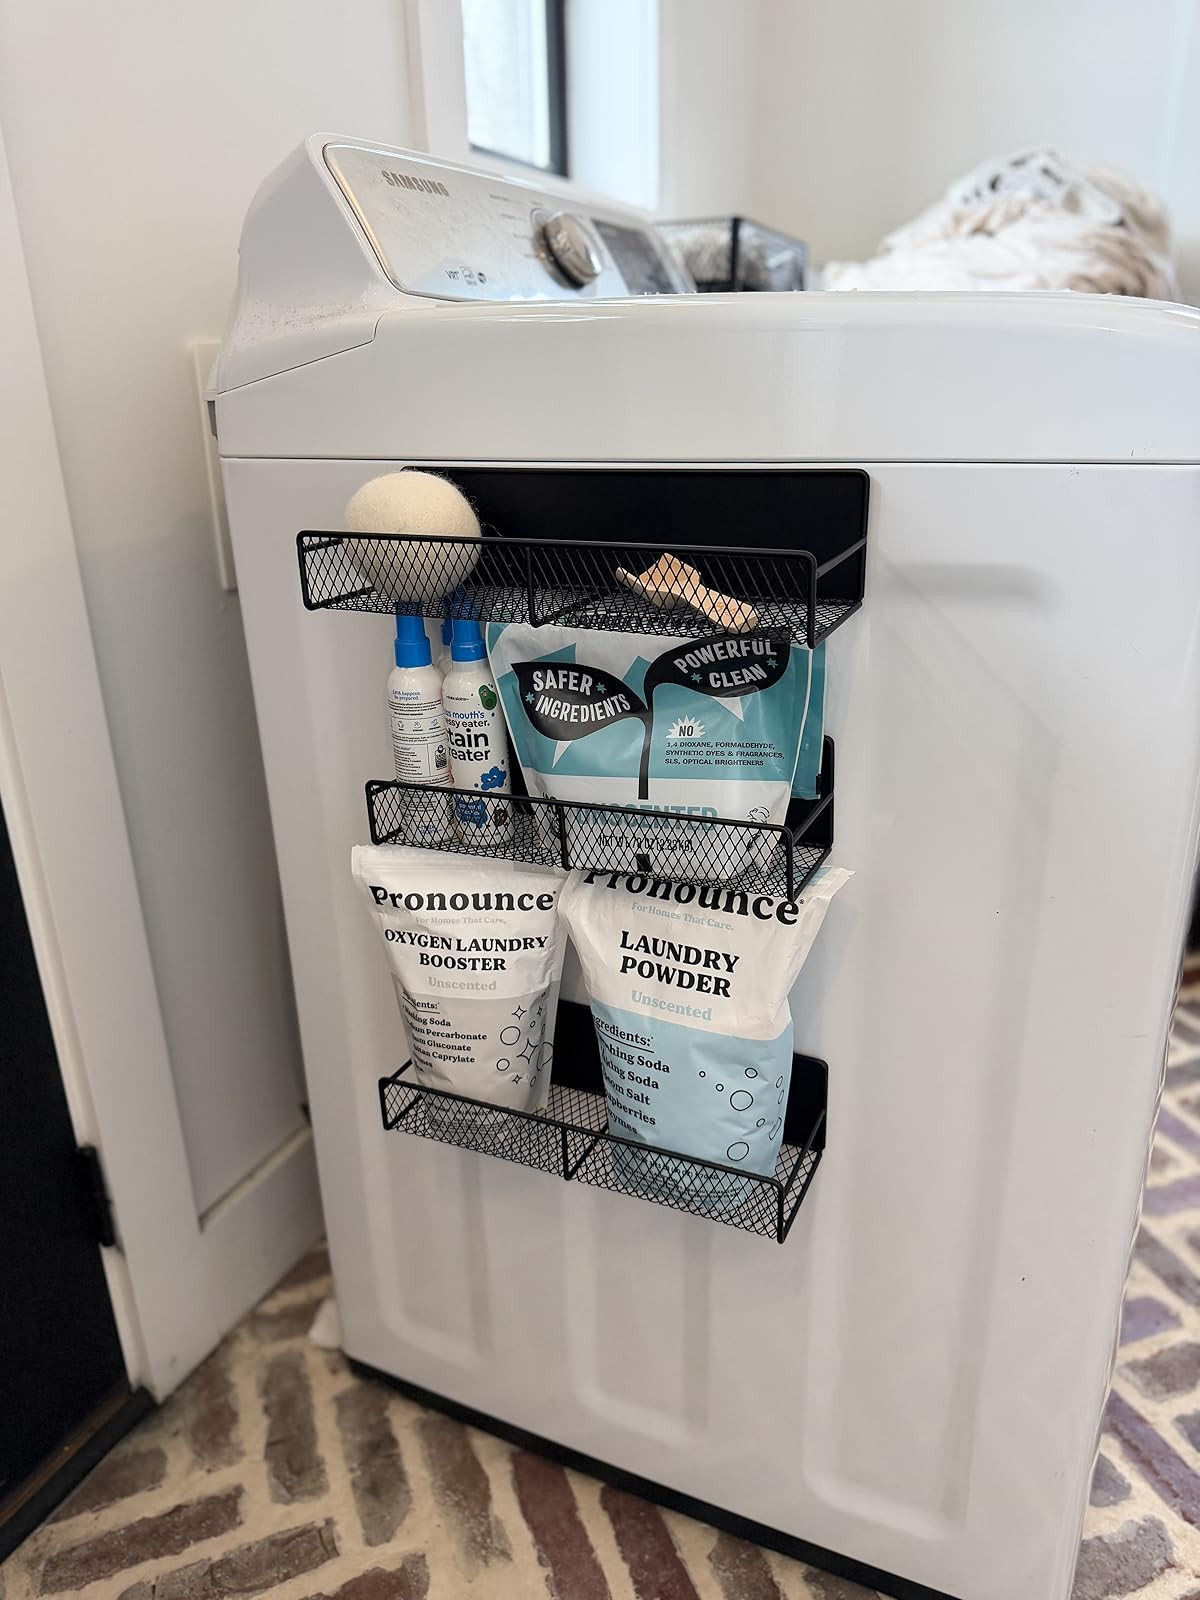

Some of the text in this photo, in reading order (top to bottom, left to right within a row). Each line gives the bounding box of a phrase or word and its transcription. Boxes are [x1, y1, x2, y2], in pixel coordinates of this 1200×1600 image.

[381, 170, 449, 197] SAMSUNG
[673, 638, 778, 674] POWERFUL
[532, 669, 593, 696] SAFER
[709, 663, 768, 688] CLEAN
[452, 711, 485, 719] mouth's
[535, 693, 631, 723] INGREDIENTS
[445, 718, 490, 728] ssy eater.
[679, 725, 694, 737] NO
[447, 728, 489, 748] tain
[680, 741, 713, 749] DIOXANE,
[715, 742, 775, 750] FORMALDEHYDE,
[448, 748, 491, 762] reater
[736, 751, 785, 760] FRAGRANCES,
[369, 885, 554, 912] Pronounce
[632, 902, 734, 931] For Homes That Care.
[384, 928, 548, 952] OXYGEN LAUNDRY
[420, 953, 506, 971] BOOSTER
[620, 930, 740, 974] LAUNDRY
[428, 977, 497, 991] Unscented
[620, 956, 731, 998] POWDER
[632, 990, 712, 1021] Unscented
[429, 1017, 451, 1027] Soda
[593, 1014, 650, 1047] gredients:
[426, 1028, 488, 1041] Percarbonate
[427, 1040, 472, 1052] Gluconate
[600, 1037, 670, 1074] hing Soda
[432, 1052, 475, 1063] Caprylate
[627, 1070, 659, 1089] Soda
[626, 1088, 650, 1105] Salt
[607, 1092, 656, 1125] apberries
